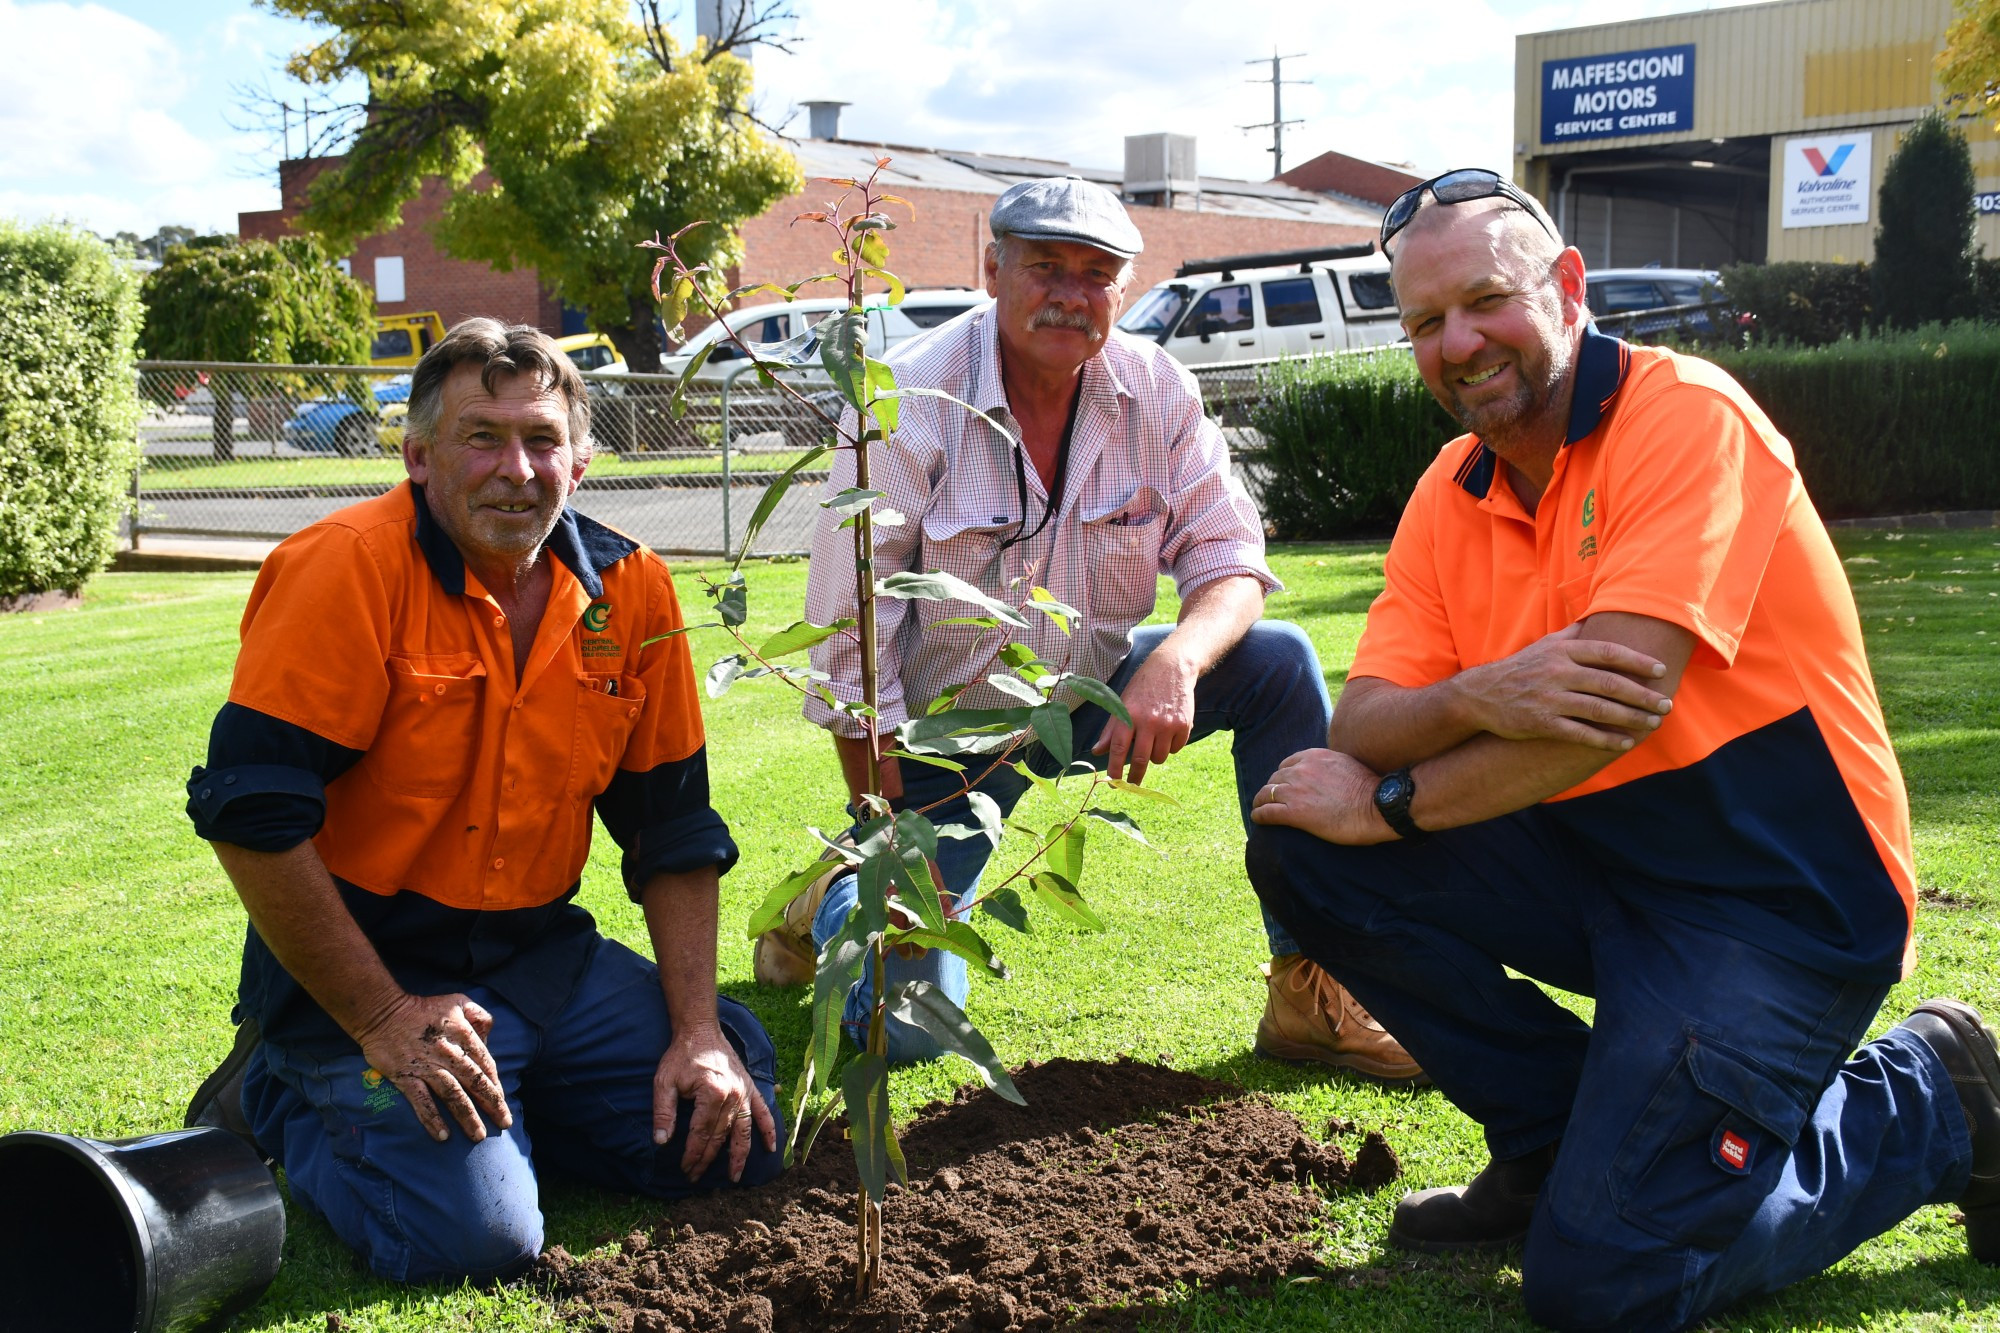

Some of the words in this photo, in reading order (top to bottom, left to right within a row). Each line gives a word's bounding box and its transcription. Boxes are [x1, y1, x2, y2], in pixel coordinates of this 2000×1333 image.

[1551, 53, 1684, 91] MAFFESCIONI
[1573, 85, 1658, 115] MOTORS
[1554, 117, 1614, 136] SERVICE
[1618, 111, 1677, 130] CENTRE
[1797, 178, 1857, 193] Valvoline
[1799, 194, 1853, 205] AUTHORISED
[1791, 206, 1825, 216] SERVICE
[1827, 203, 1860, 213] CENTRE
[1725, 1138, 1744, 1154] Hard
